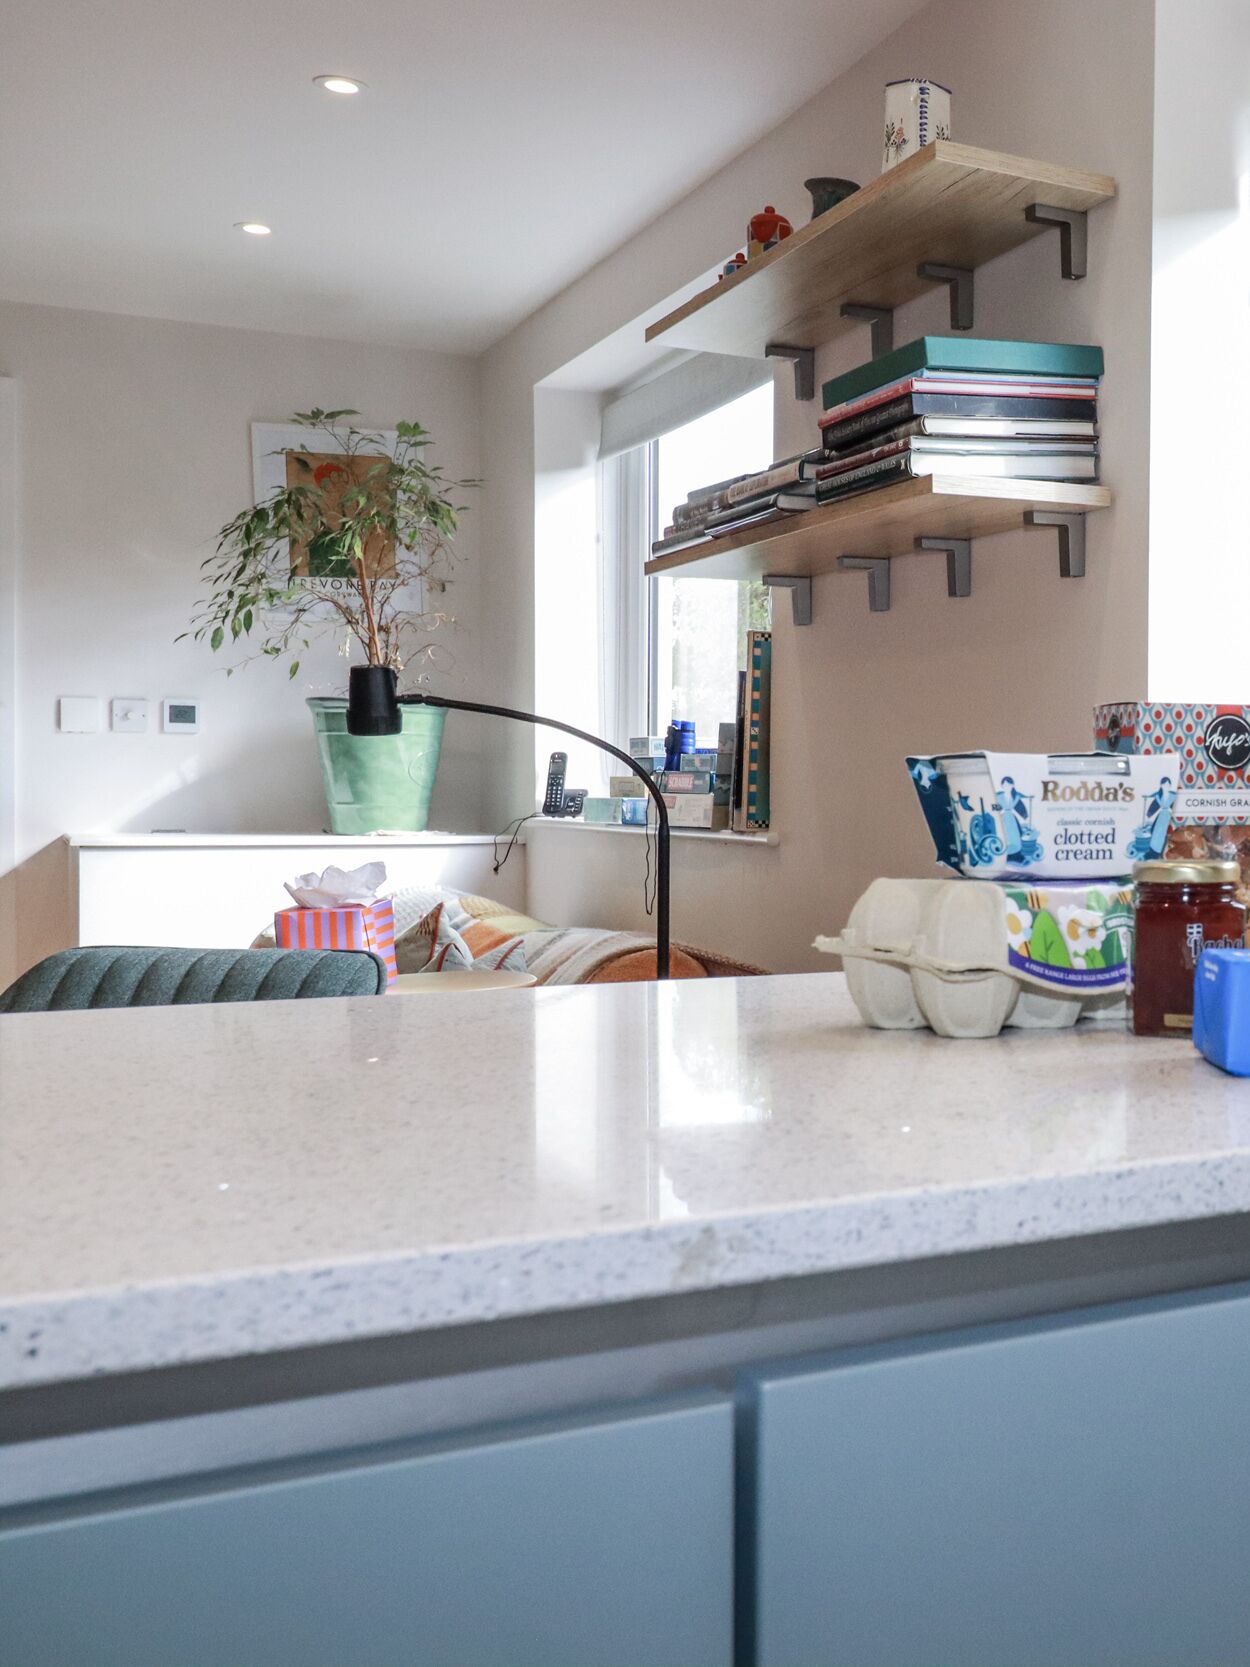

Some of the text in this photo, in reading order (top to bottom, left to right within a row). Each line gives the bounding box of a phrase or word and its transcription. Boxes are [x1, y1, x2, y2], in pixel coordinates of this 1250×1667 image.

[1041, 780, 1136, 803] Rodda's
[1185, 798, 1227, 807] CORNISH
[1084, 817, 1116, 826] cornish
[1053, 827, 1116, 846] clotted
[1055, 848, 1113, 861] cream
